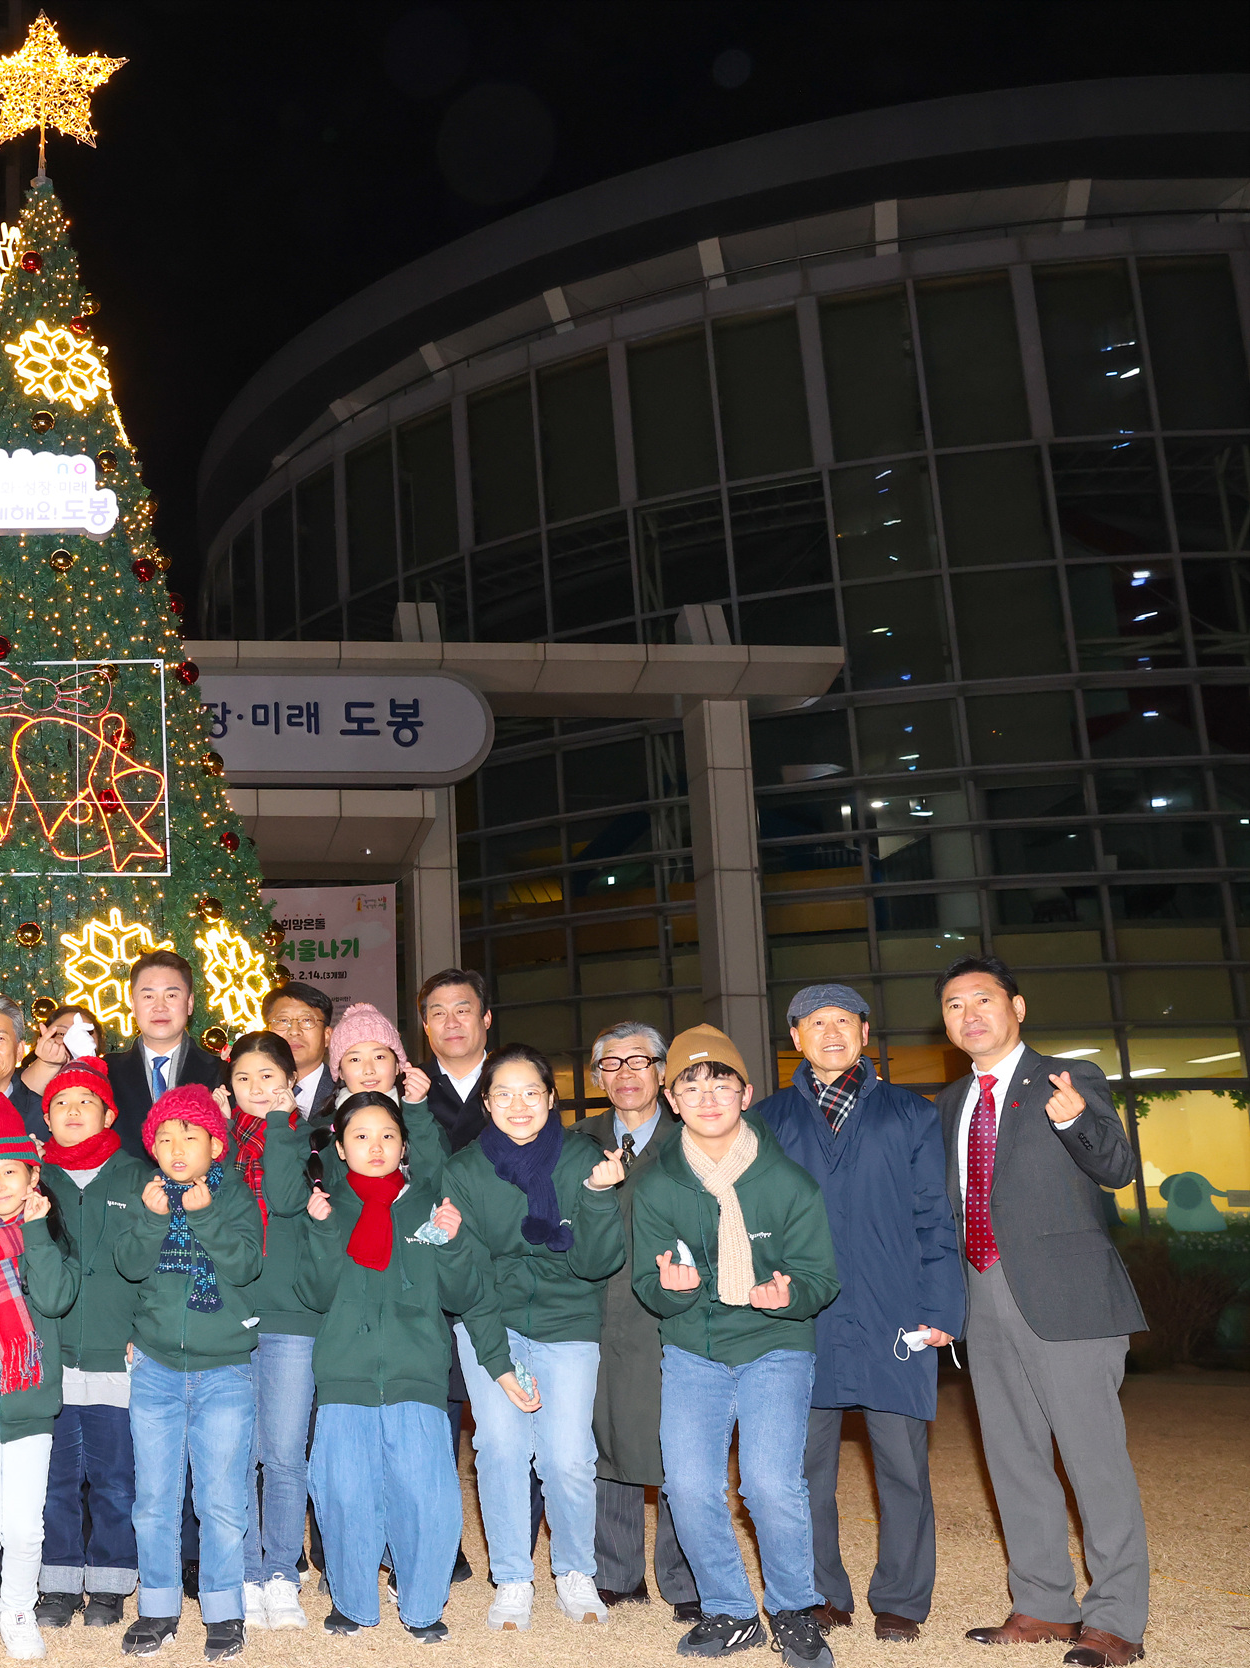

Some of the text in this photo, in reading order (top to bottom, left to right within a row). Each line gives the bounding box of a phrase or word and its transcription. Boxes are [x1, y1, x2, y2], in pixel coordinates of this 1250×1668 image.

[62, 496, 110, 526] 도봉
[339, 698, 424, 747] 도봉
[281, 918, 326, 931] 희망온돌
[276, 937, 359, 962] 겨울나기
